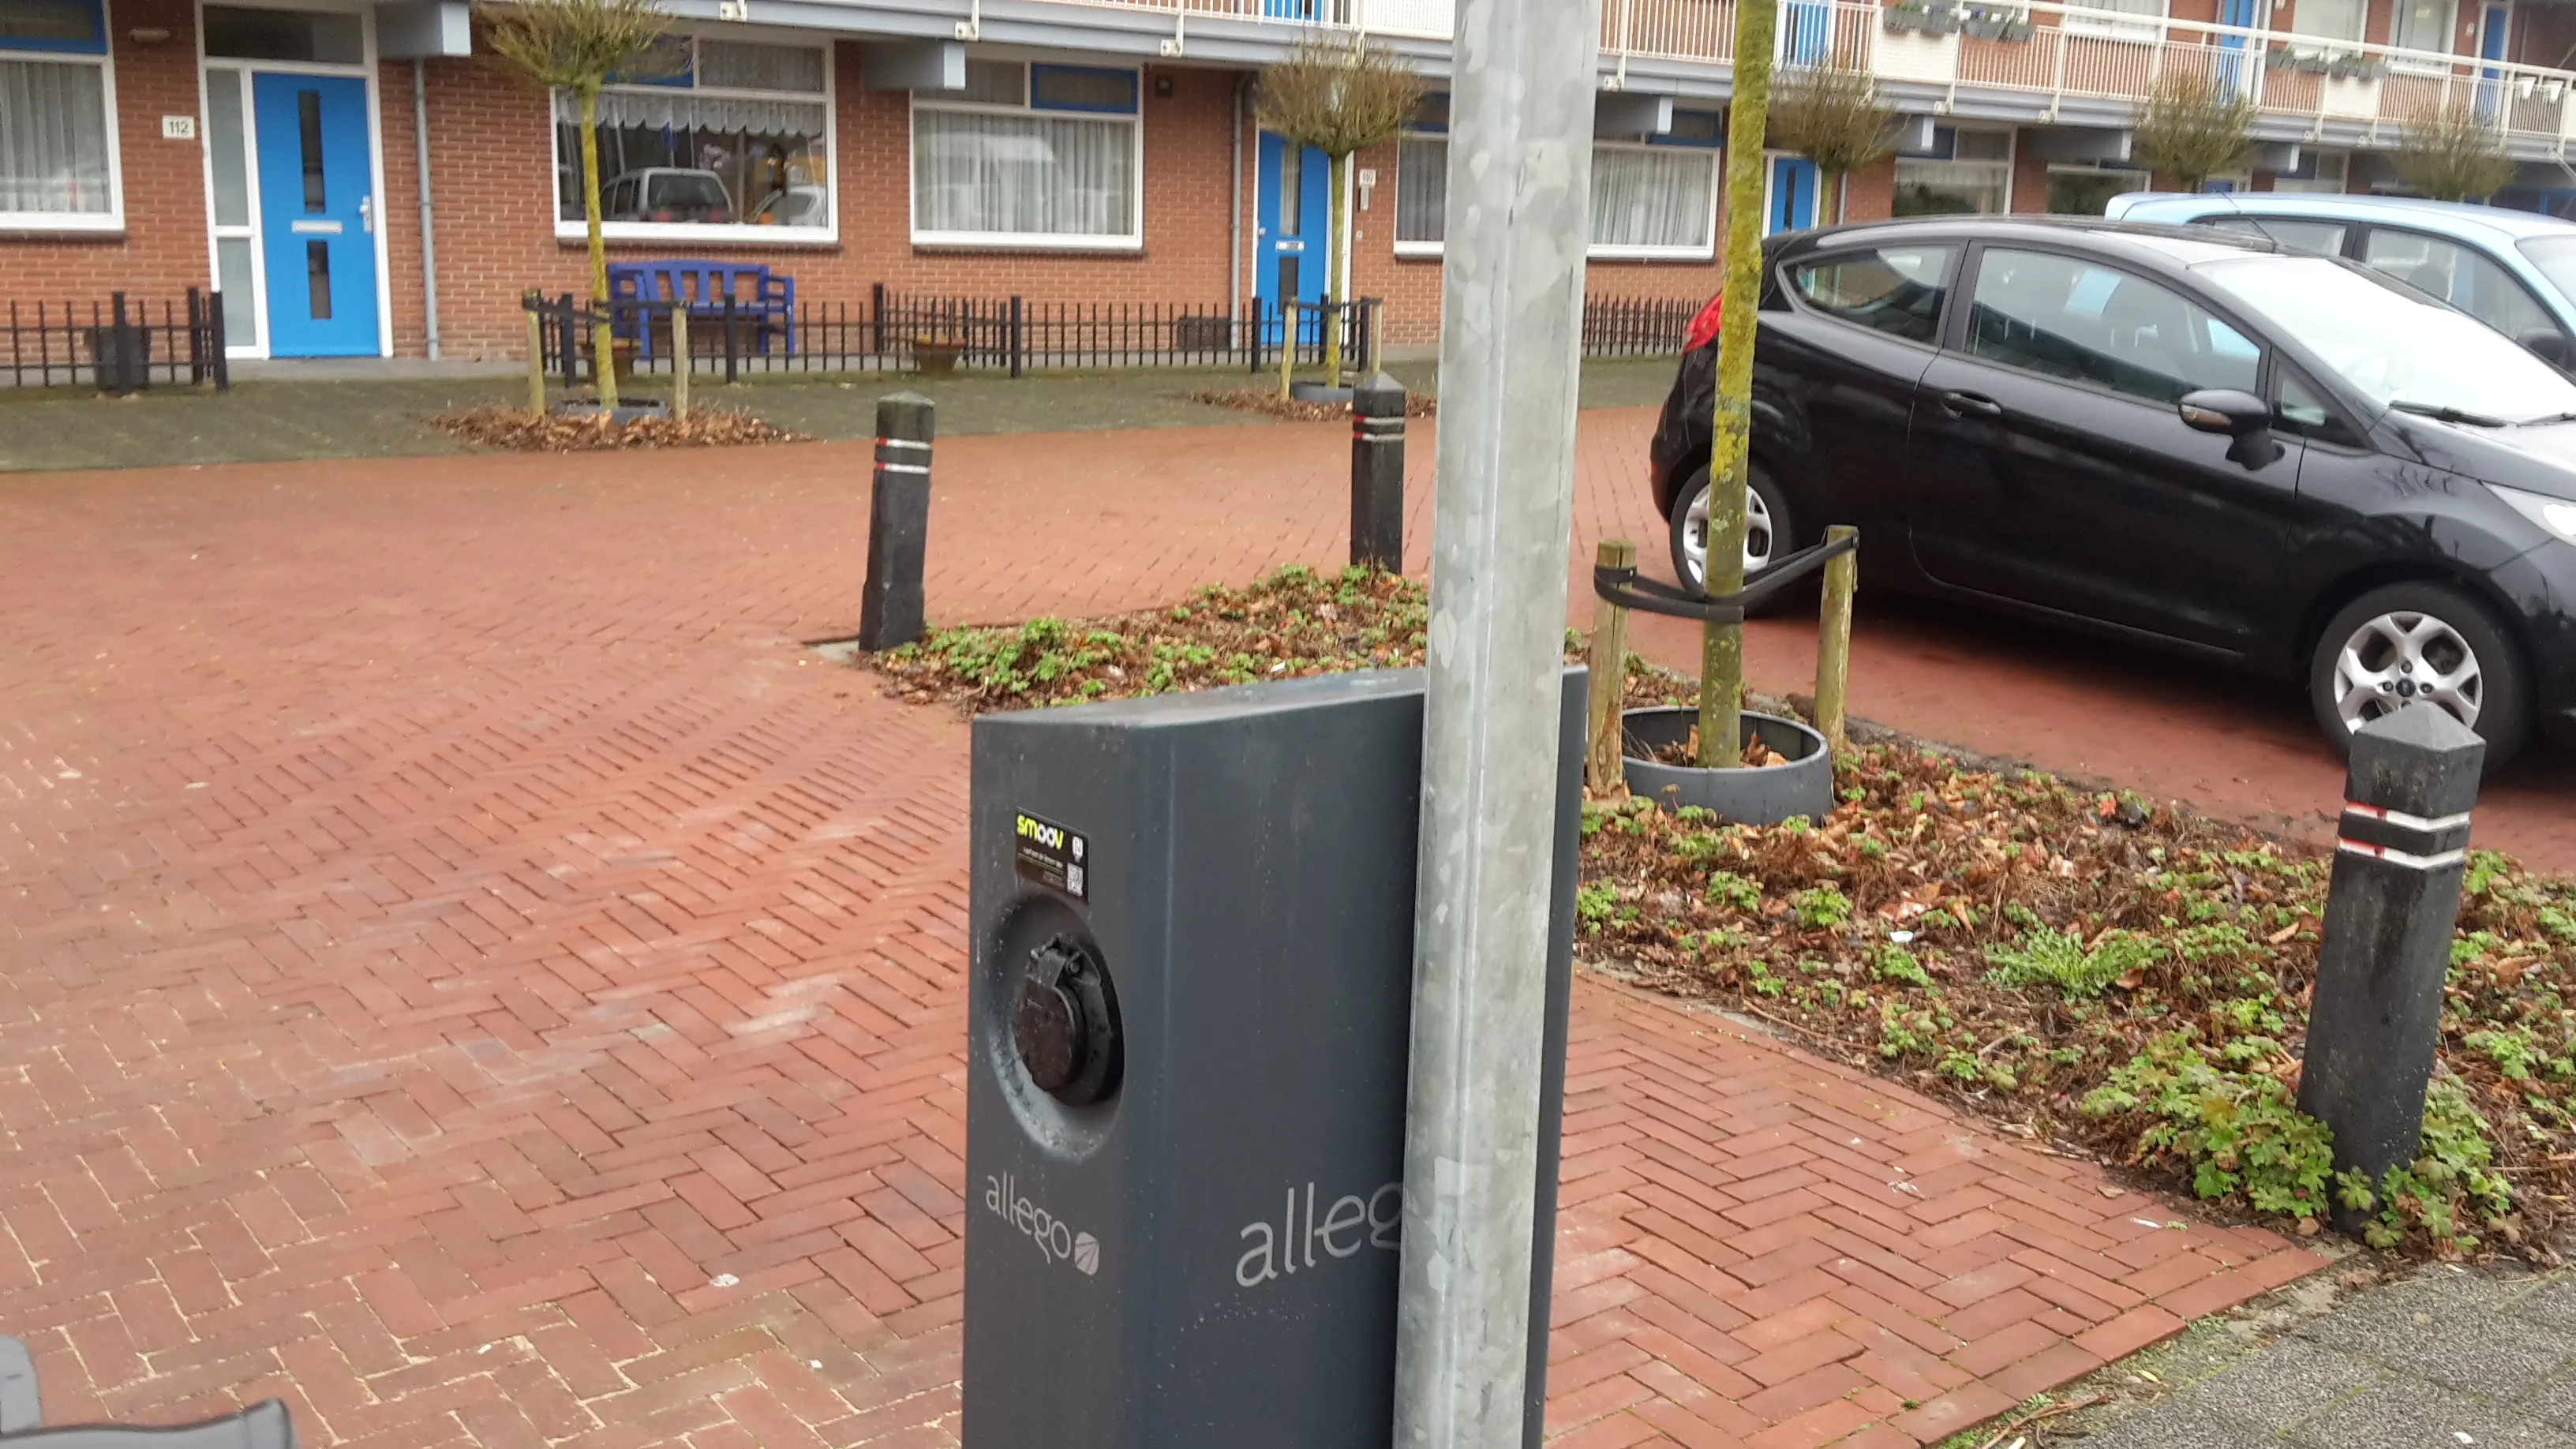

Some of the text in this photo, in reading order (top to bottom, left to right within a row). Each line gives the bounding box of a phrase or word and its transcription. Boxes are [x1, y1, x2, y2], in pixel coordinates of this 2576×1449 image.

[169, 119, 189, 137] 112
[1017, 814, 1064, 851] smoov
[985, 1170, 1072, 1264] allego
[1236, 1181, 1403, 1287] alleg
